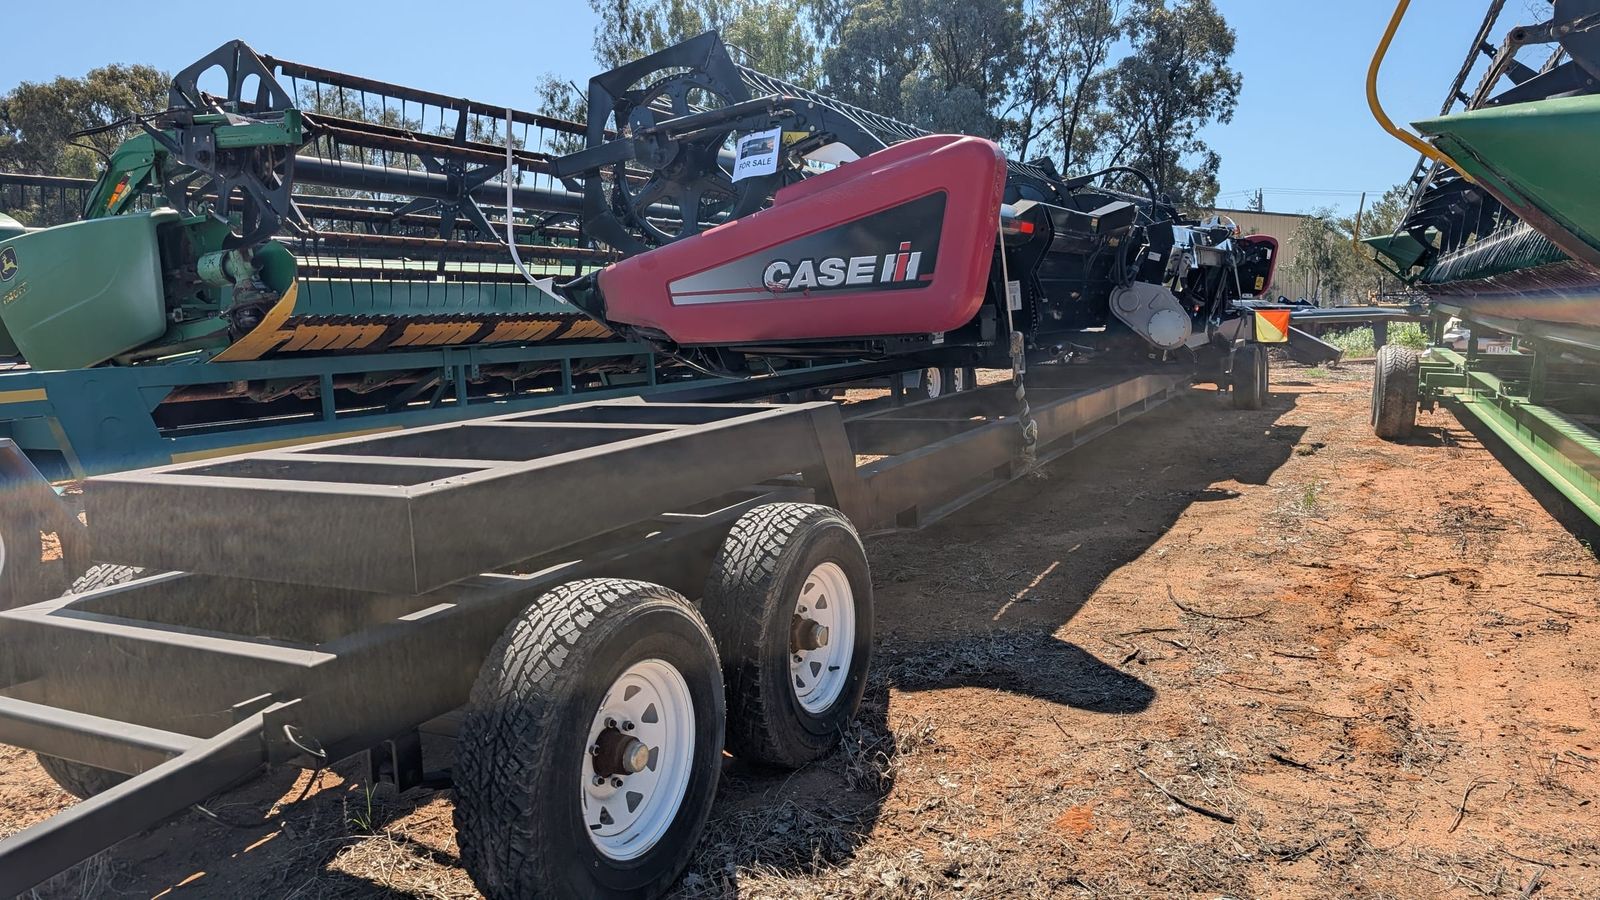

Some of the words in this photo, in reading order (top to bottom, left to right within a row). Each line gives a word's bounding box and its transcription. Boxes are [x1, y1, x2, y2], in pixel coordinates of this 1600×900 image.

[739, 160, 751, 170] FOR
[752, 158, 772, 167] SALE
[763, 255, 878, 289] CASE
